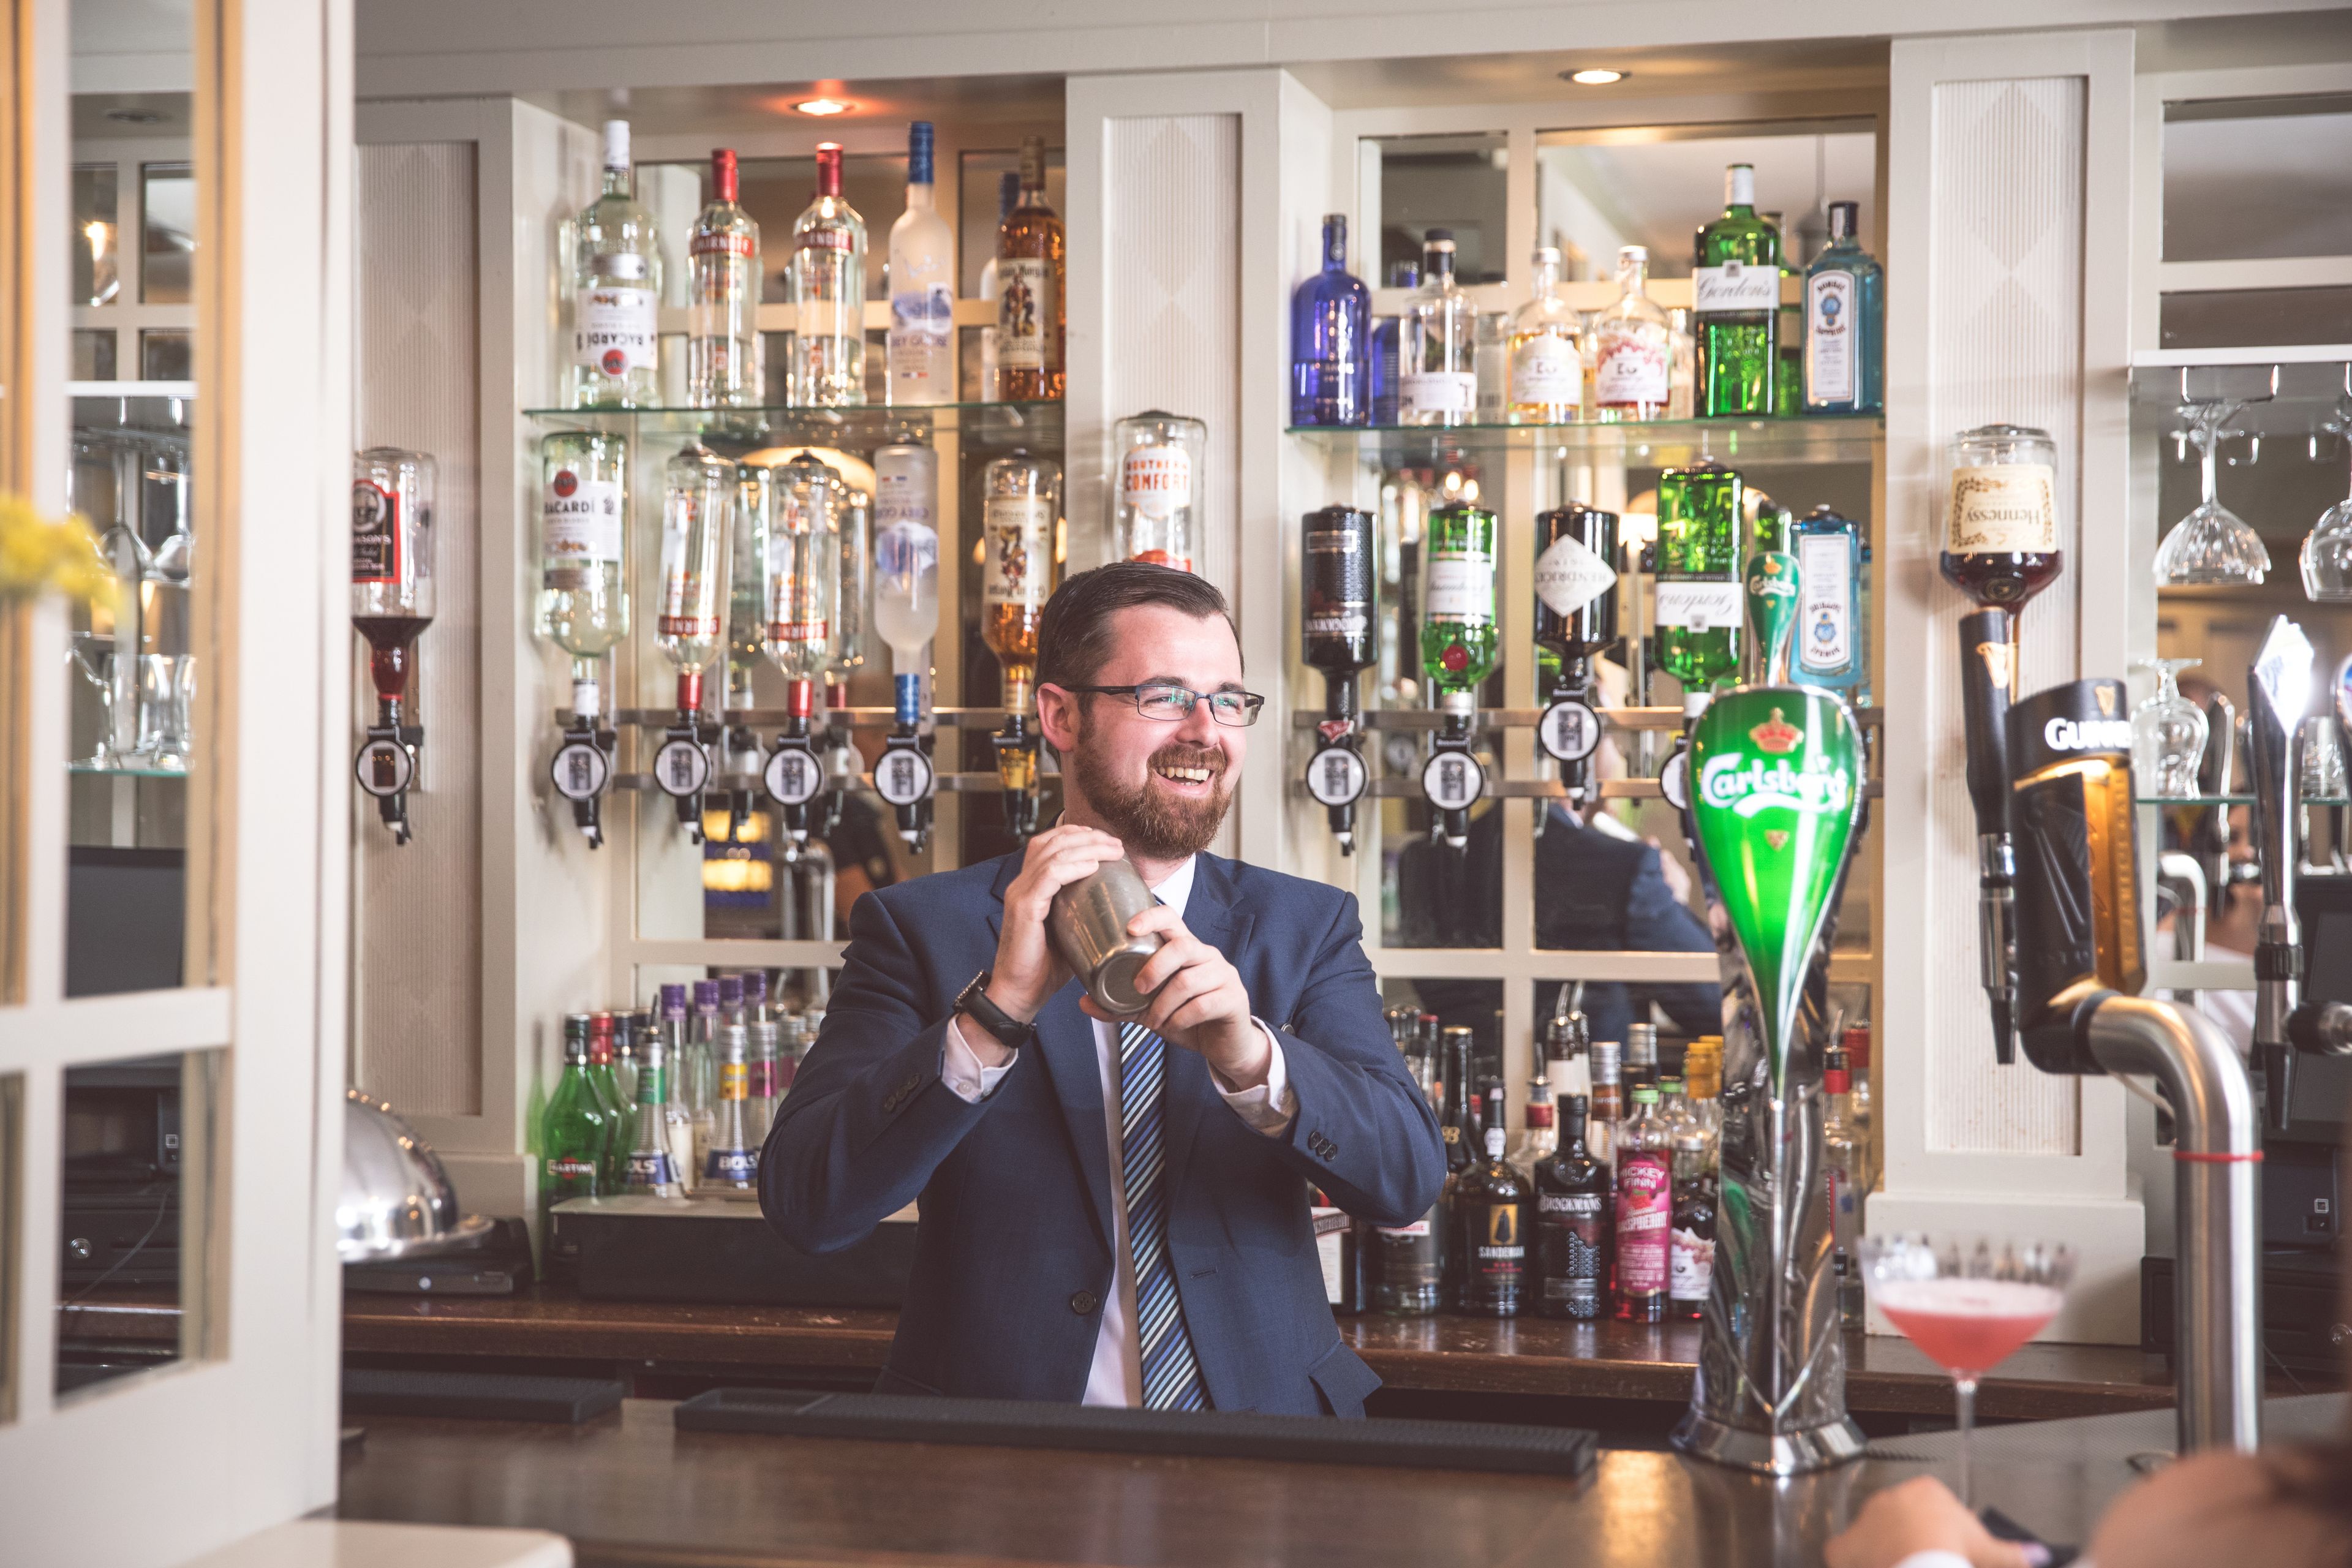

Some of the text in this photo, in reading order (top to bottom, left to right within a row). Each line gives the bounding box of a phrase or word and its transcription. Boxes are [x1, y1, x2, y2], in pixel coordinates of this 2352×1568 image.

[1698, 276, 1773, 300] Gordon's
[1126, 473, 1187, 491] COMFORT
[1966, 507, 2040, 524] Hennessy
[1749, 575, 1796, 597] Carlsberg
[1658, 592, 1733, 616] Gordon's
[1700, 752, 1850, 818] Carlsberg
[624, 1159, 658, 1174] OLS
[718, 1156, 759, 1170] BOLS
[1539, 1194, 1602, 1213] BROCKMANS
[1478, 1246, 1525, 1259] SANDEMAN
